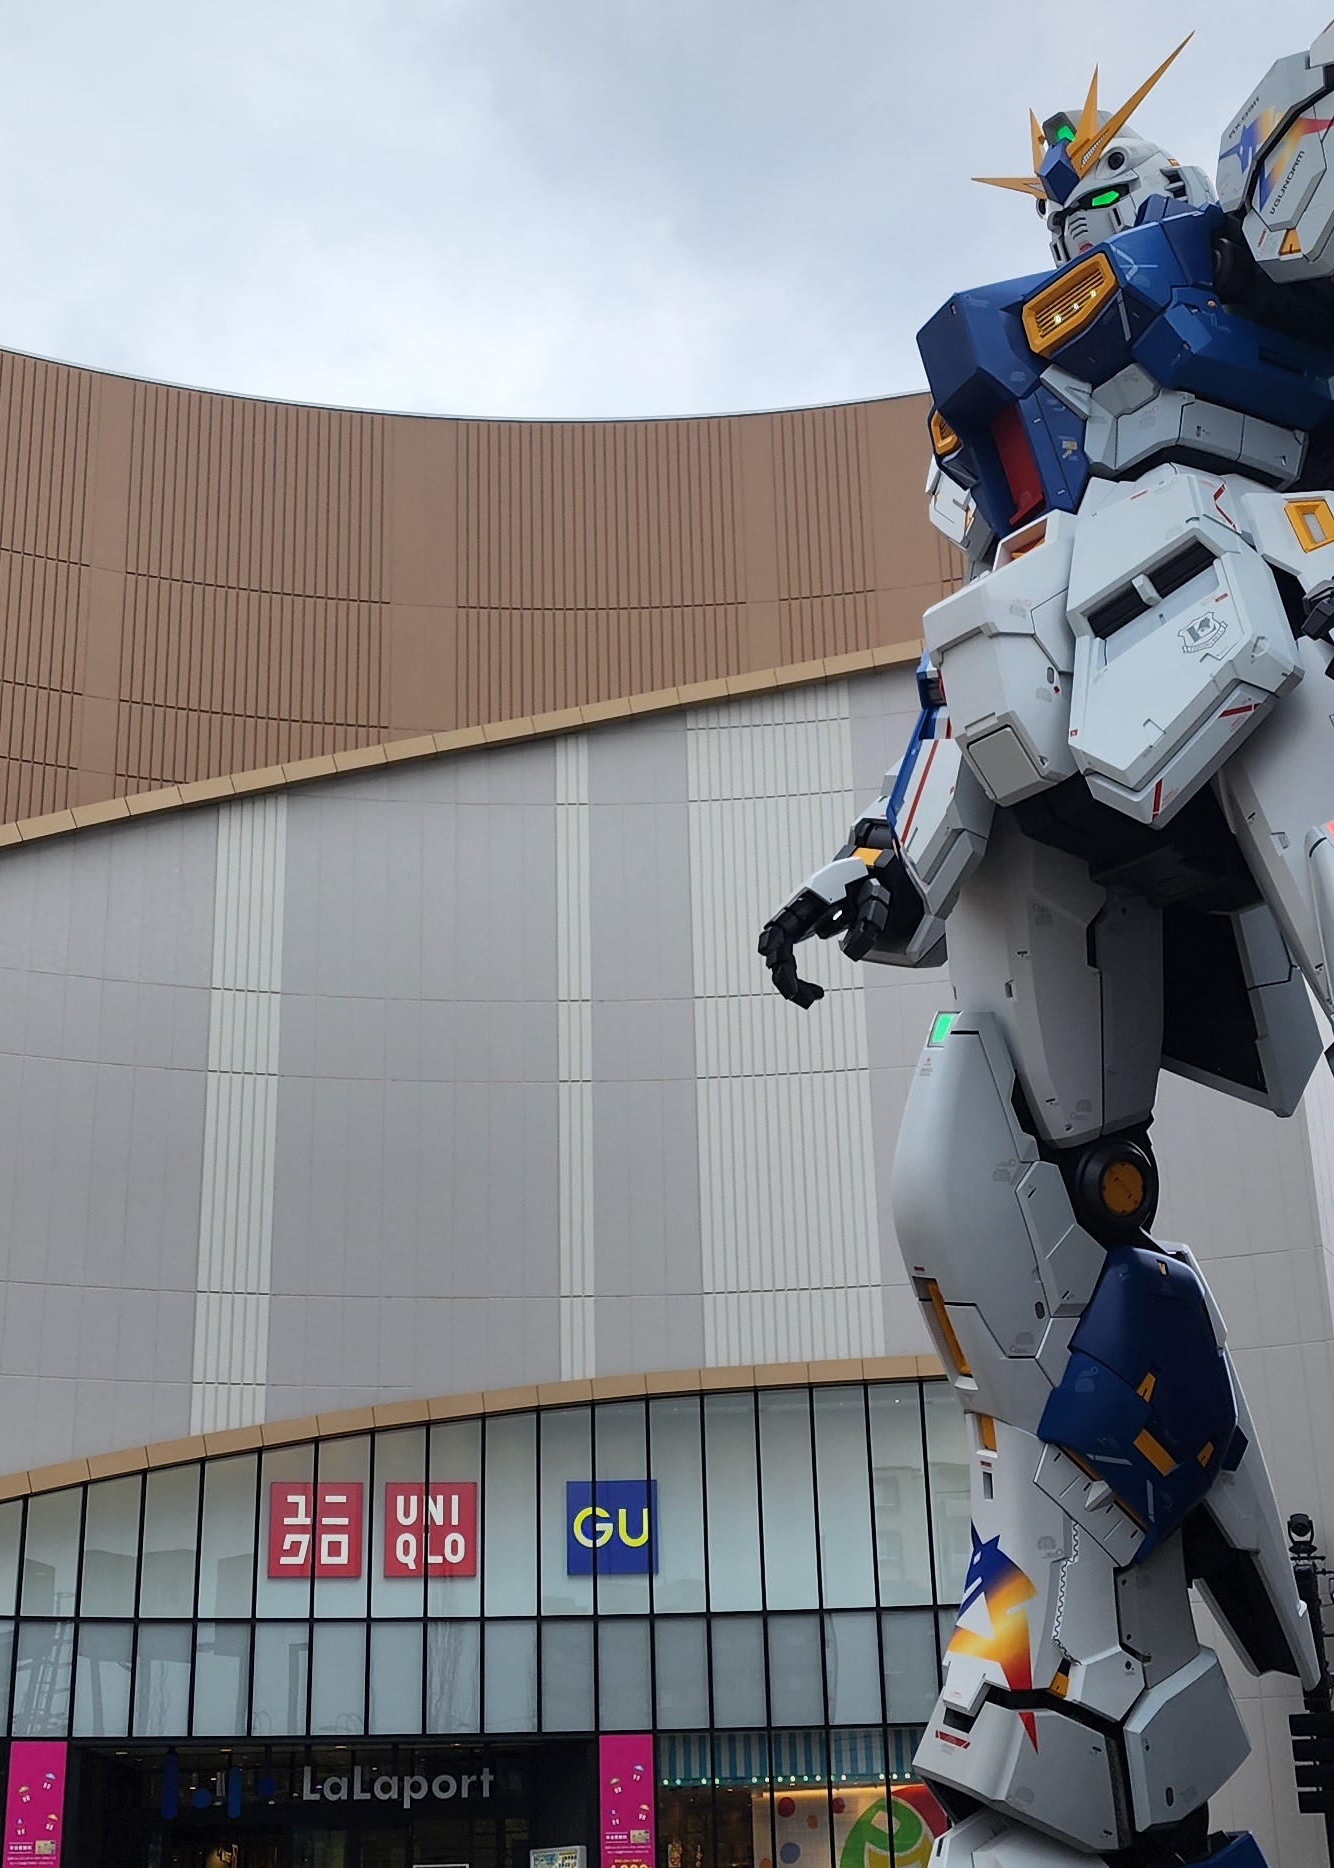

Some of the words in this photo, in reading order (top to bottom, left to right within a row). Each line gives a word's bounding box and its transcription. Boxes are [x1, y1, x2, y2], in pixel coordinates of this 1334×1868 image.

[396, 1495, 459, 1526] UNI
[573, 1506, 650, 1549] GU
[395, 1532, 466, 1570] QLO
[303, 1766, 494, 1809] LaLaport
